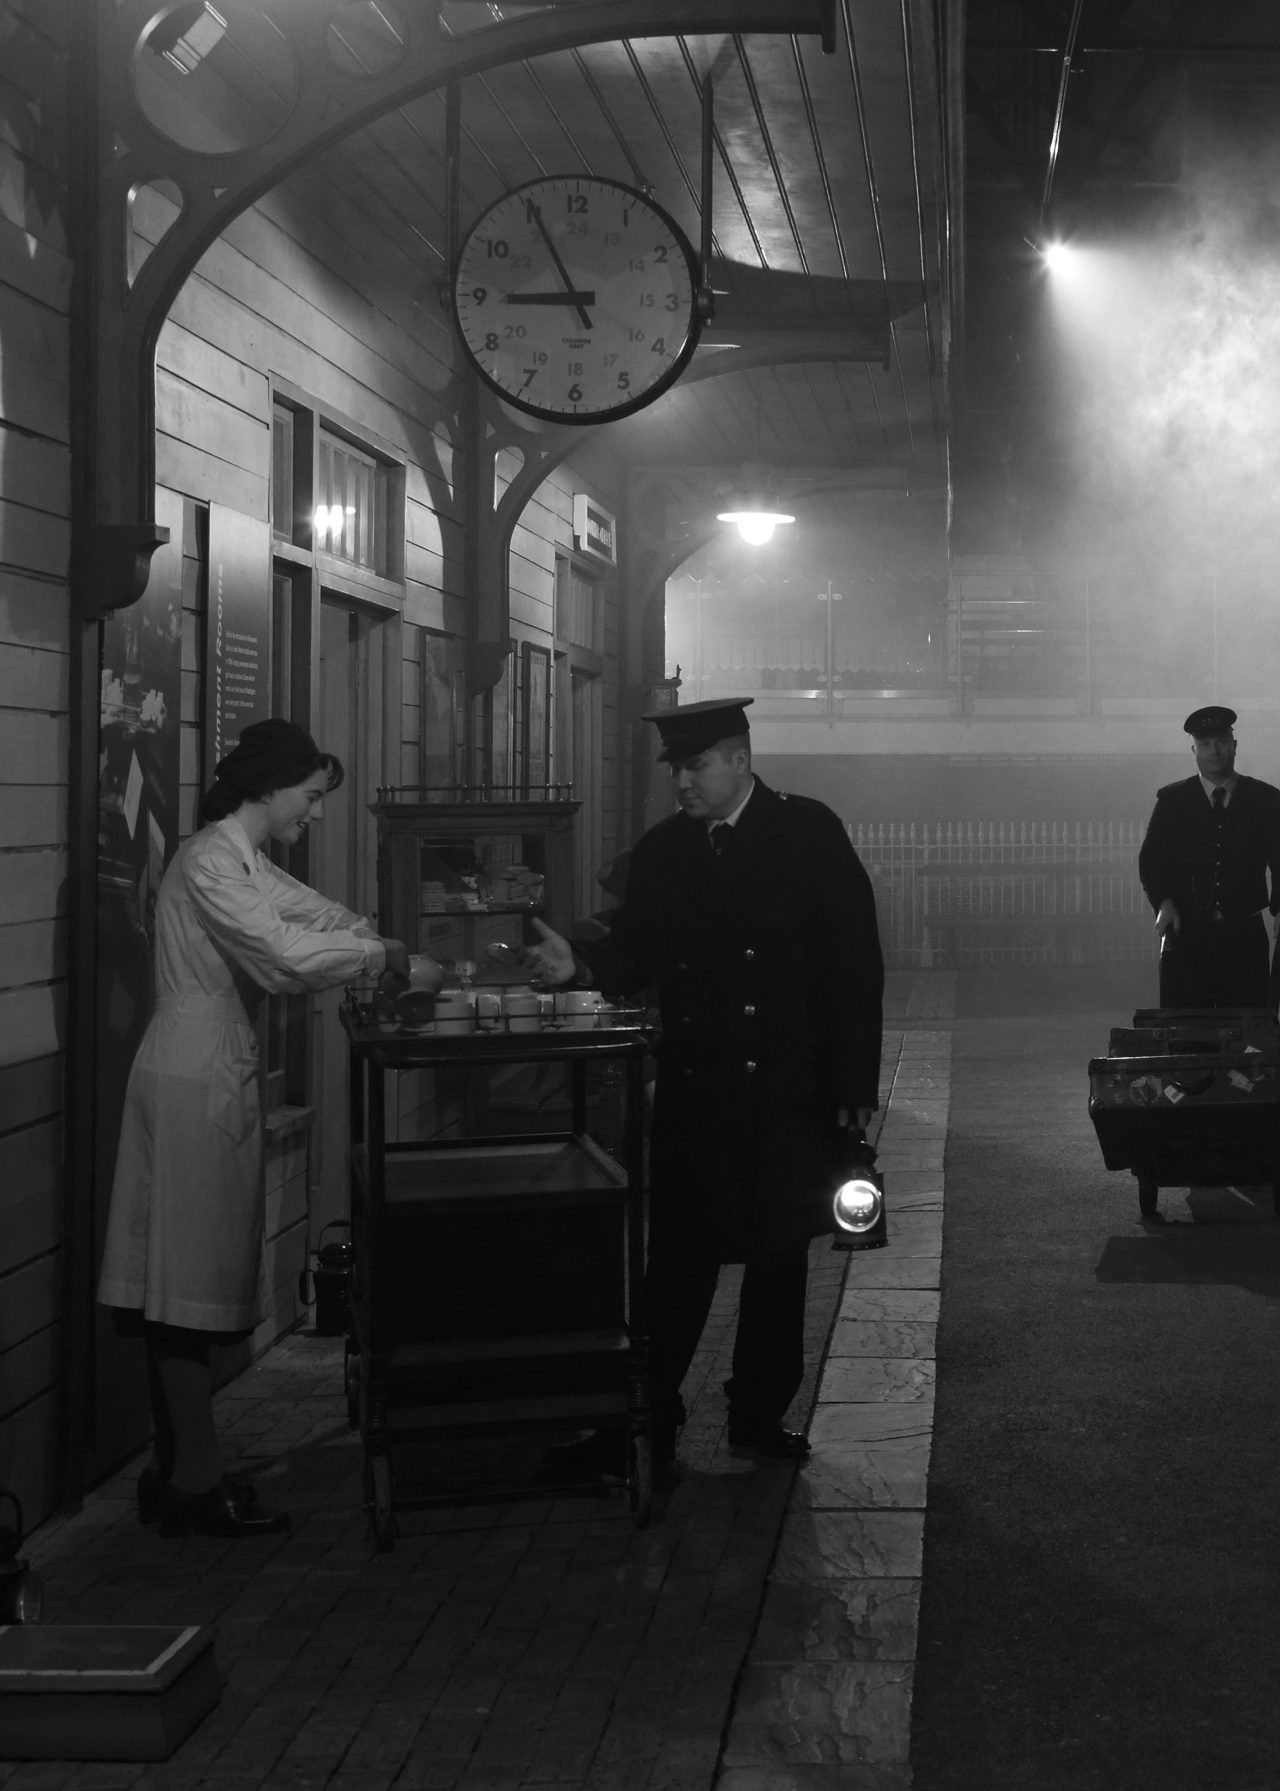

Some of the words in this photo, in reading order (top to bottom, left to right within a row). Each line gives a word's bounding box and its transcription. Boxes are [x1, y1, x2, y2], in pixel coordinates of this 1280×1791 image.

[567, 194, 589, 214] 12
[623, 209, 628, 227] 1
[566, 222, 589, 236] 24
[604, 232, 621, 246] 13
[487, 239, 510, 258] 10
[654, 245, 669, 263] 2
[511, 255, 532, 269] 22
[629, 258, 646, 272] 14
[472, 287, 488, 306] 9
[639, 293, 654, 308] 15
[665, 293, 680, 312] 3
[503, 325, 527, 339] 20
[628, 328, 646, 343] 16
[485, 332, 500, 352] 8
[651, 337, 666, 356] 4
[533, 351, 549, 366] 19
[604, 354, 619, 367] 17
[523, 369, 538, 387] 7
[568, 362, 584, 376] 18
[617, 371, 631, 390] 5
[568, 383, 583, 402] 6
[216, 563, 224, 657] Rooms
[214, 664, 222, 767] shment
